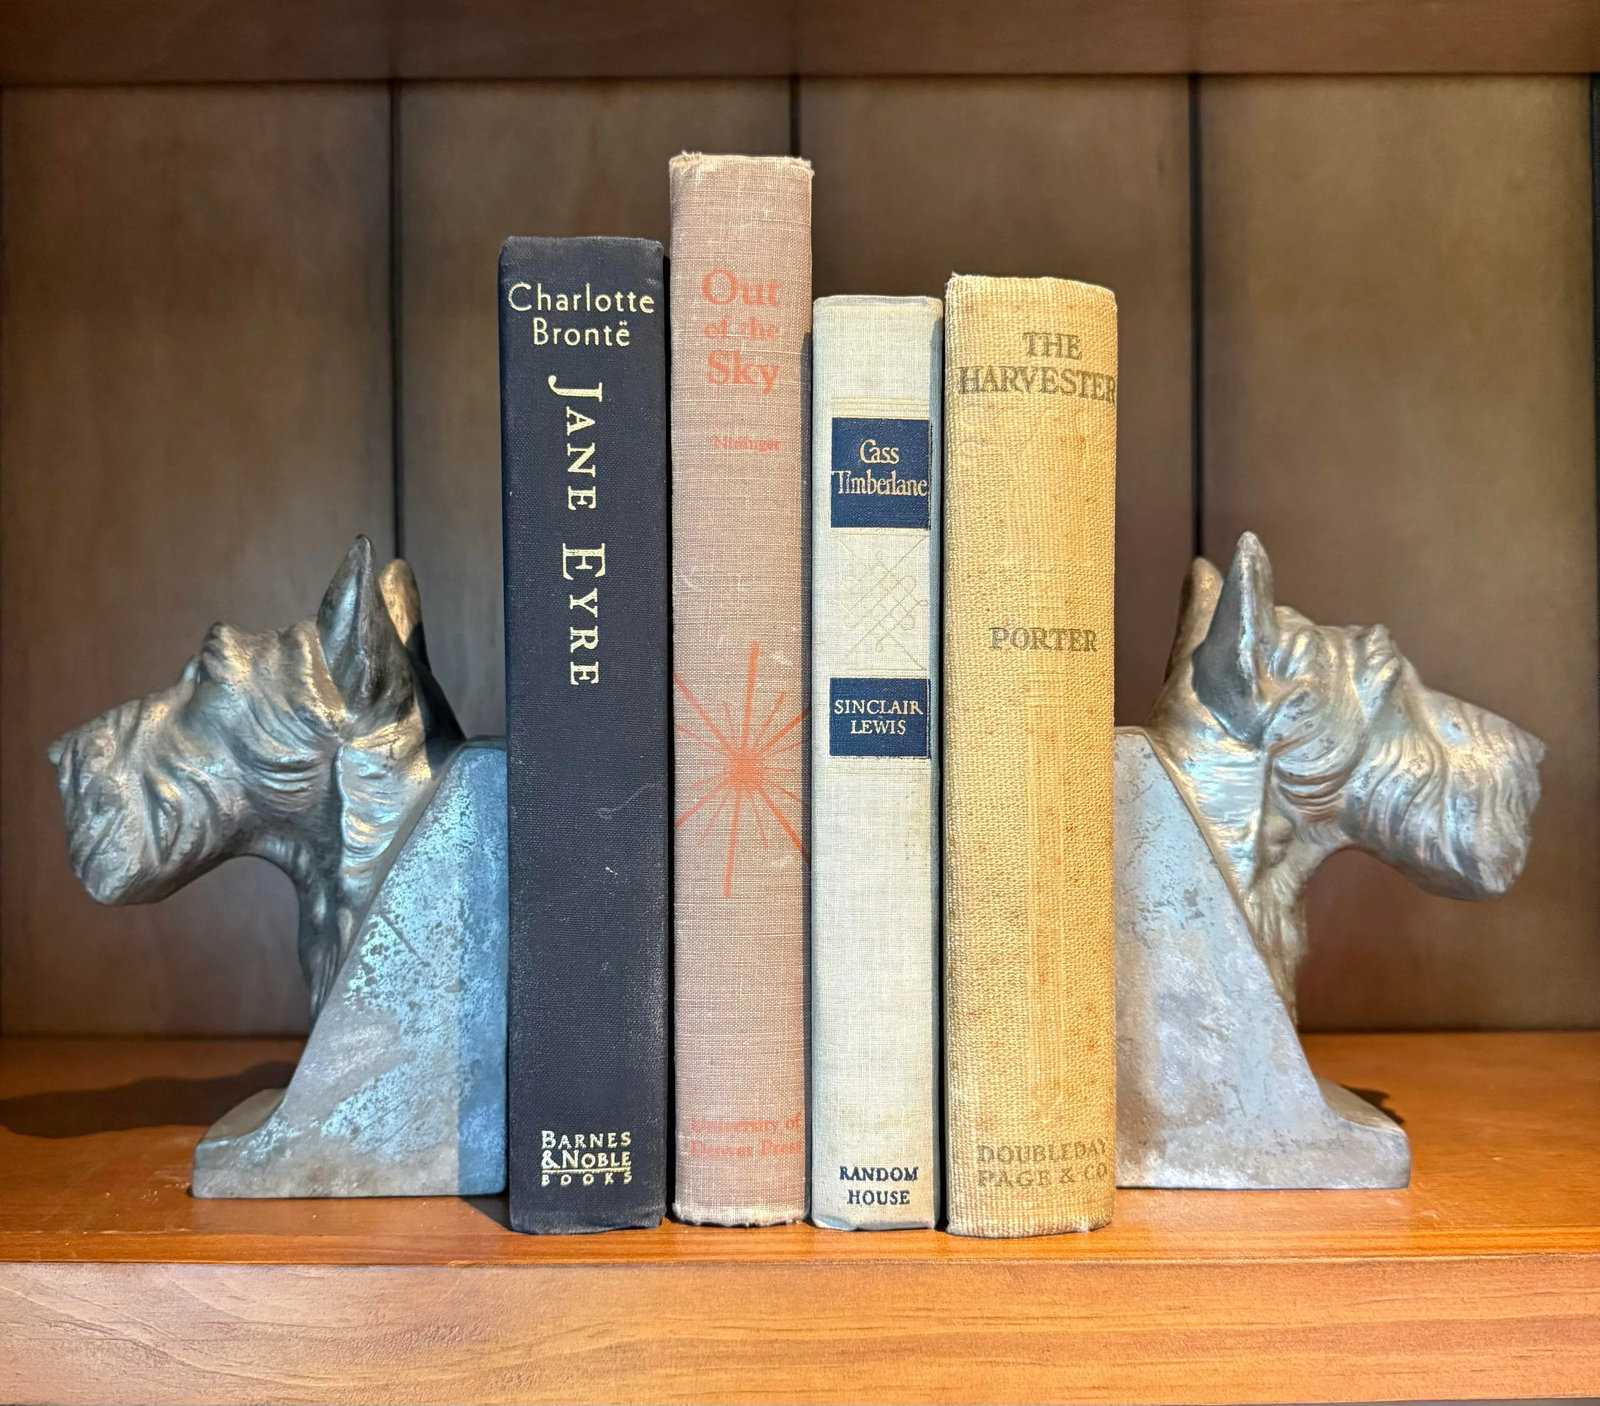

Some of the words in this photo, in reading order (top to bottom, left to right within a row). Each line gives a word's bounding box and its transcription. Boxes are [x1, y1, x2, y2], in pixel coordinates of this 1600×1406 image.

[508, 283, 655, 313] Charlotte
[702, 269, 780, 307] Out
[533, 318, 631, 347] Brontë
[704, 314, 729, 340] of
[1022, 332, 1083, 360] THE
[706, 350, 780, 395] Sky
[957, 365, 1116, 403] HARVESTER
[548, 375, 603, 510] JANE
[859, 439, 900, 464] Cass
[831, 469, 929, 497] Timberlane
[562, 543, 606, 686] EYRE
[988, 627, 1098, 652] PORTER
[834, 699, 924, 716] SINCLAIR
[850, 719, 907, 735] LEWIS
[541, 1130, 632, 1149] BARNES
[976, 1138, 1107, 1164] DOUBLEDAY
[541, 1171, 632, 1186] BOOKS
[839, 1166, 919, 1182] RANDOM
[977, 1169, 1051, 1188] PAGE
[1060, 1167, 1075, 1184] &
[847, 1189, 910, 1205] HOUSE
